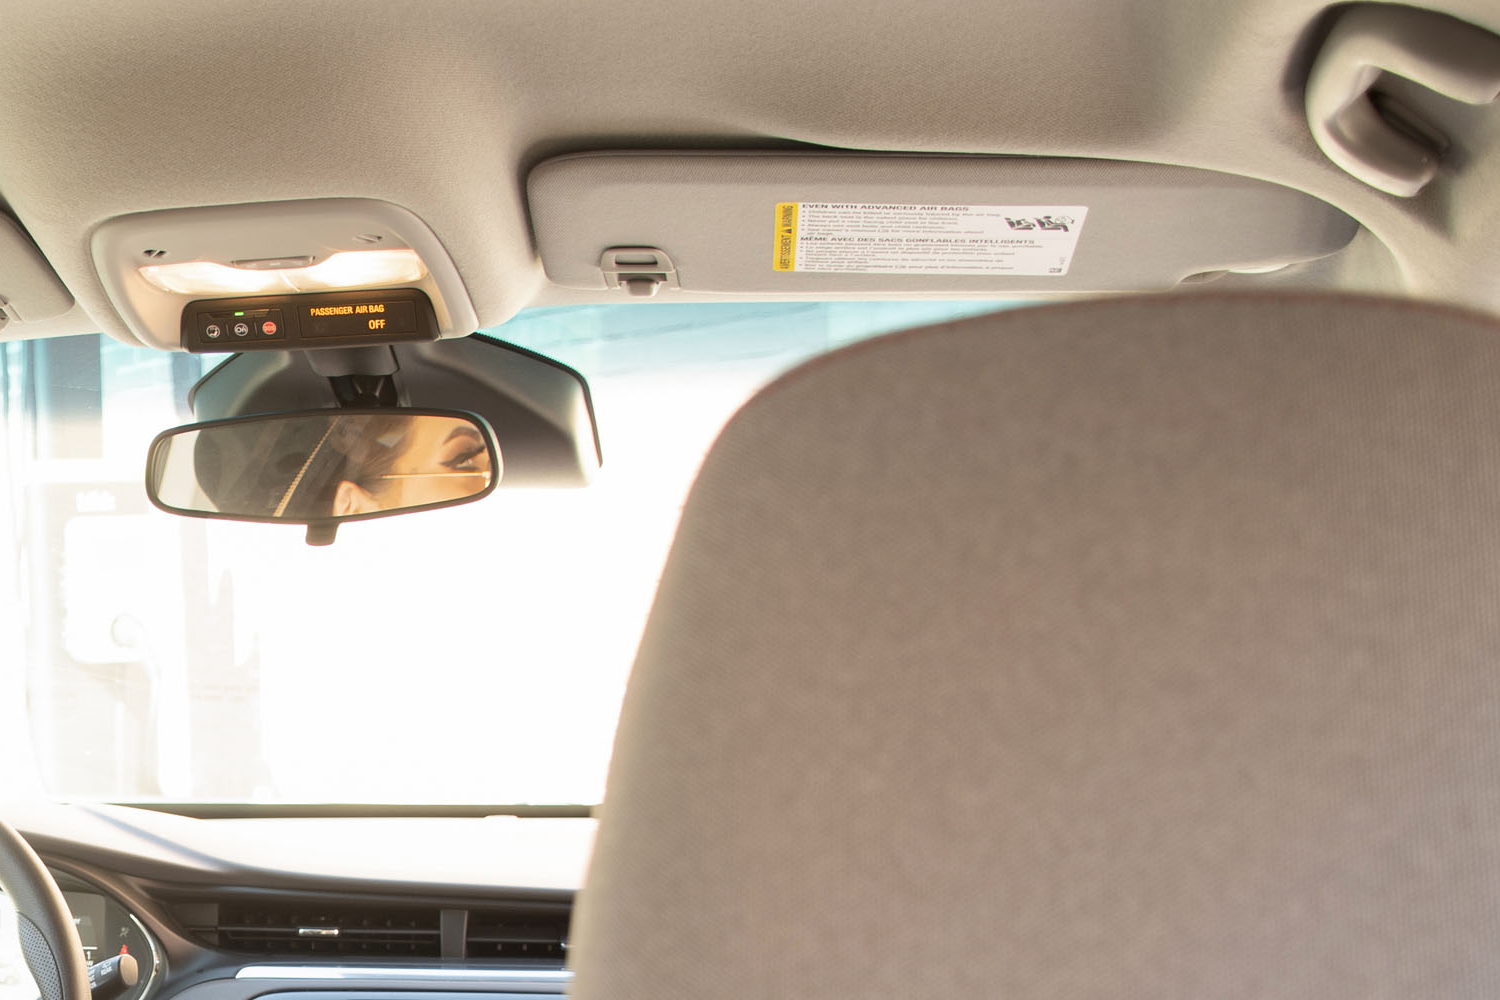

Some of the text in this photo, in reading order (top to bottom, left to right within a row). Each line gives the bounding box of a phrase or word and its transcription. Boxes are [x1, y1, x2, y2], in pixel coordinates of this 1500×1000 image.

[310, 304, 385, 317] PASSENGER AIR BAG
[368, 319, 386, 330] OFF
